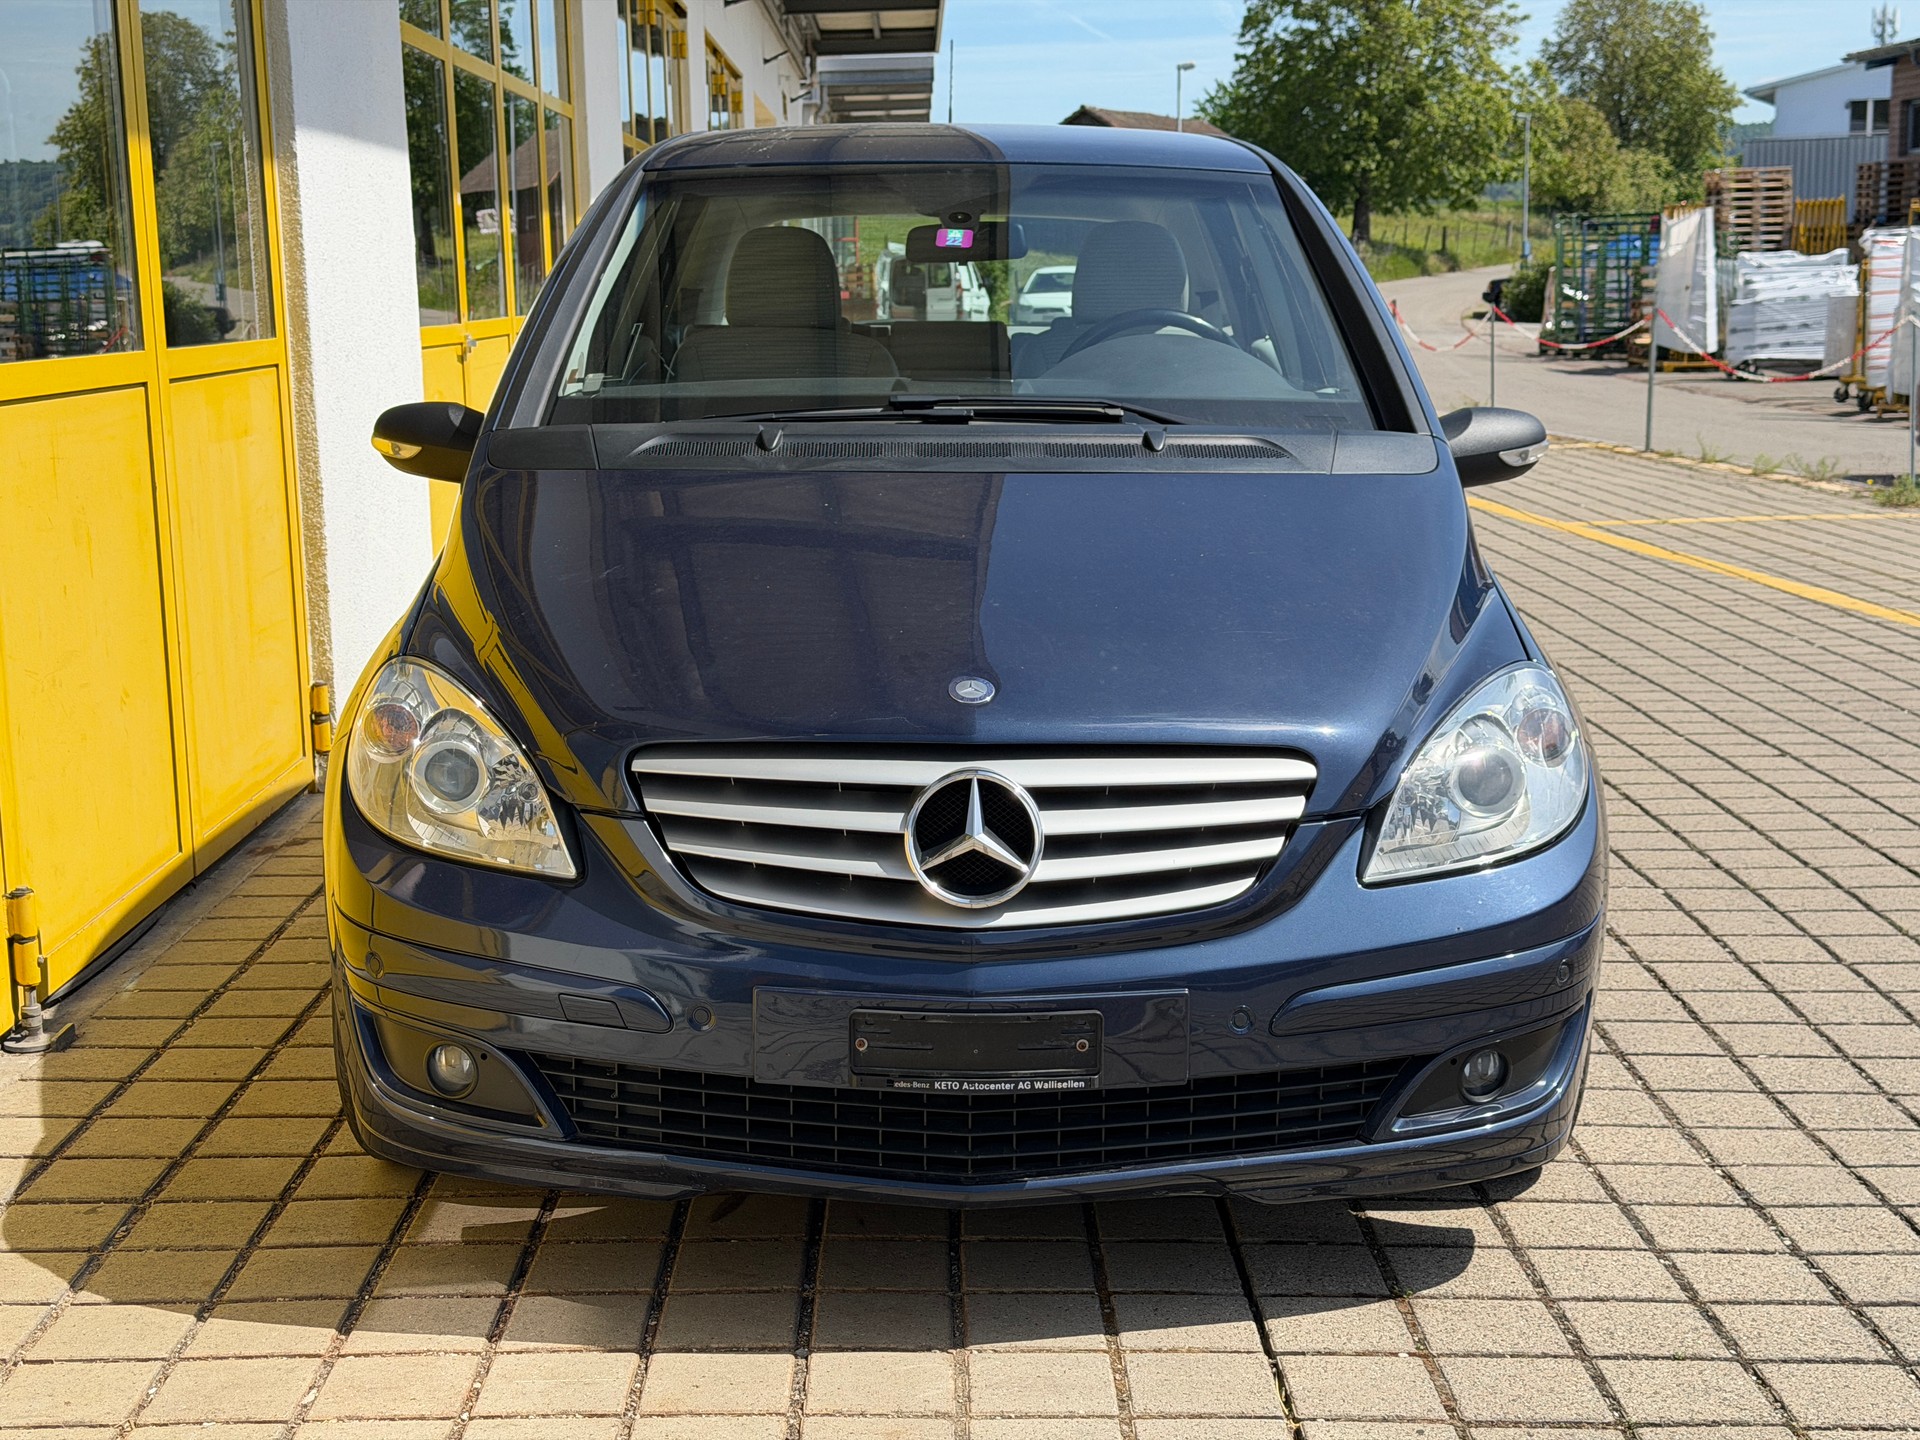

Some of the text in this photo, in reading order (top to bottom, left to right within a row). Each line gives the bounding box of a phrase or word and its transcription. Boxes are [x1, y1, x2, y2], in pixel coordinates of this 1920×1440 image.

[945, 237, 963, 246] 22
[934, 1081, 960, 1090] KETO
[1018, 1081, 1031, 1090] AG
[1034, 1080, 1085, 1089] Wallisellen
